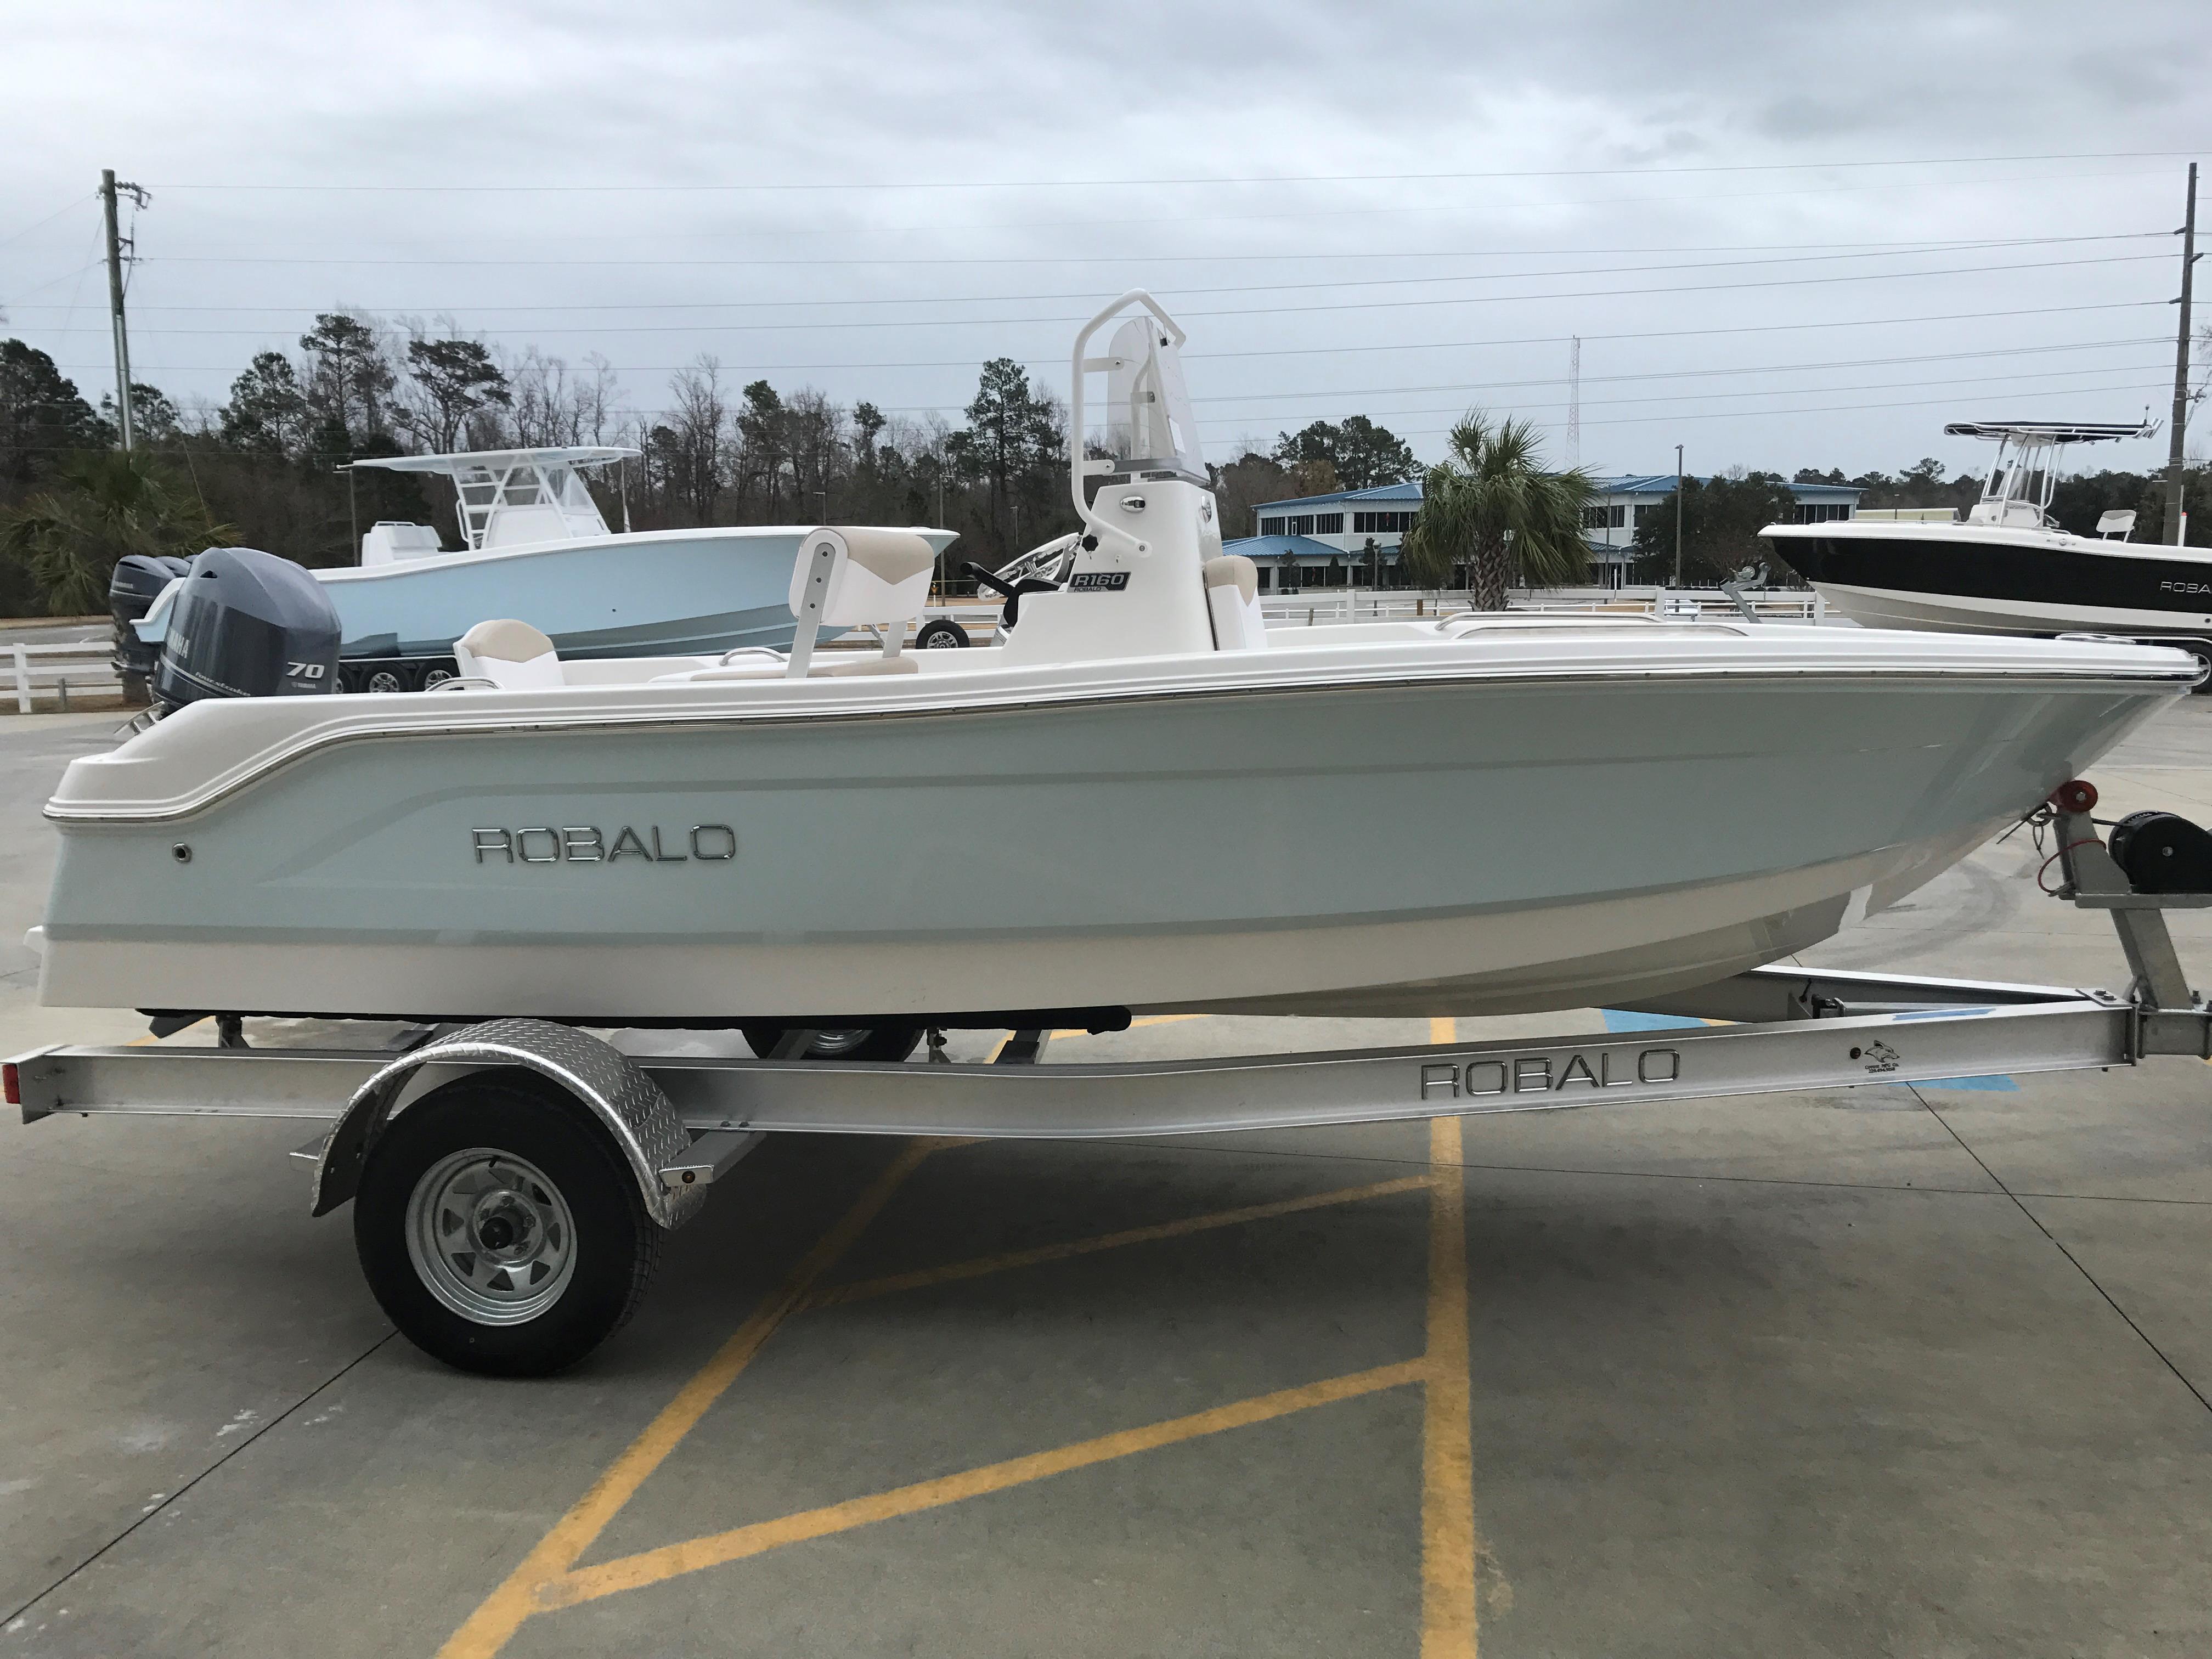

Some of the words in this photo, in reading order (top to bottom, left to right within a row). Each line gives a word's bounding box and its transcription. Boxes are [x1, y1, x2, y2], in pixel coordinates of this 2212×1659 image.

[1074, 575, 1125, 586] R160
[2160, 582, 2212, 594] ROBA
[286, 662, 325, 679] 70
[472, 824, 736, 864] ROBALO
[1421, 1048, 1680, 1099] ROBALO
